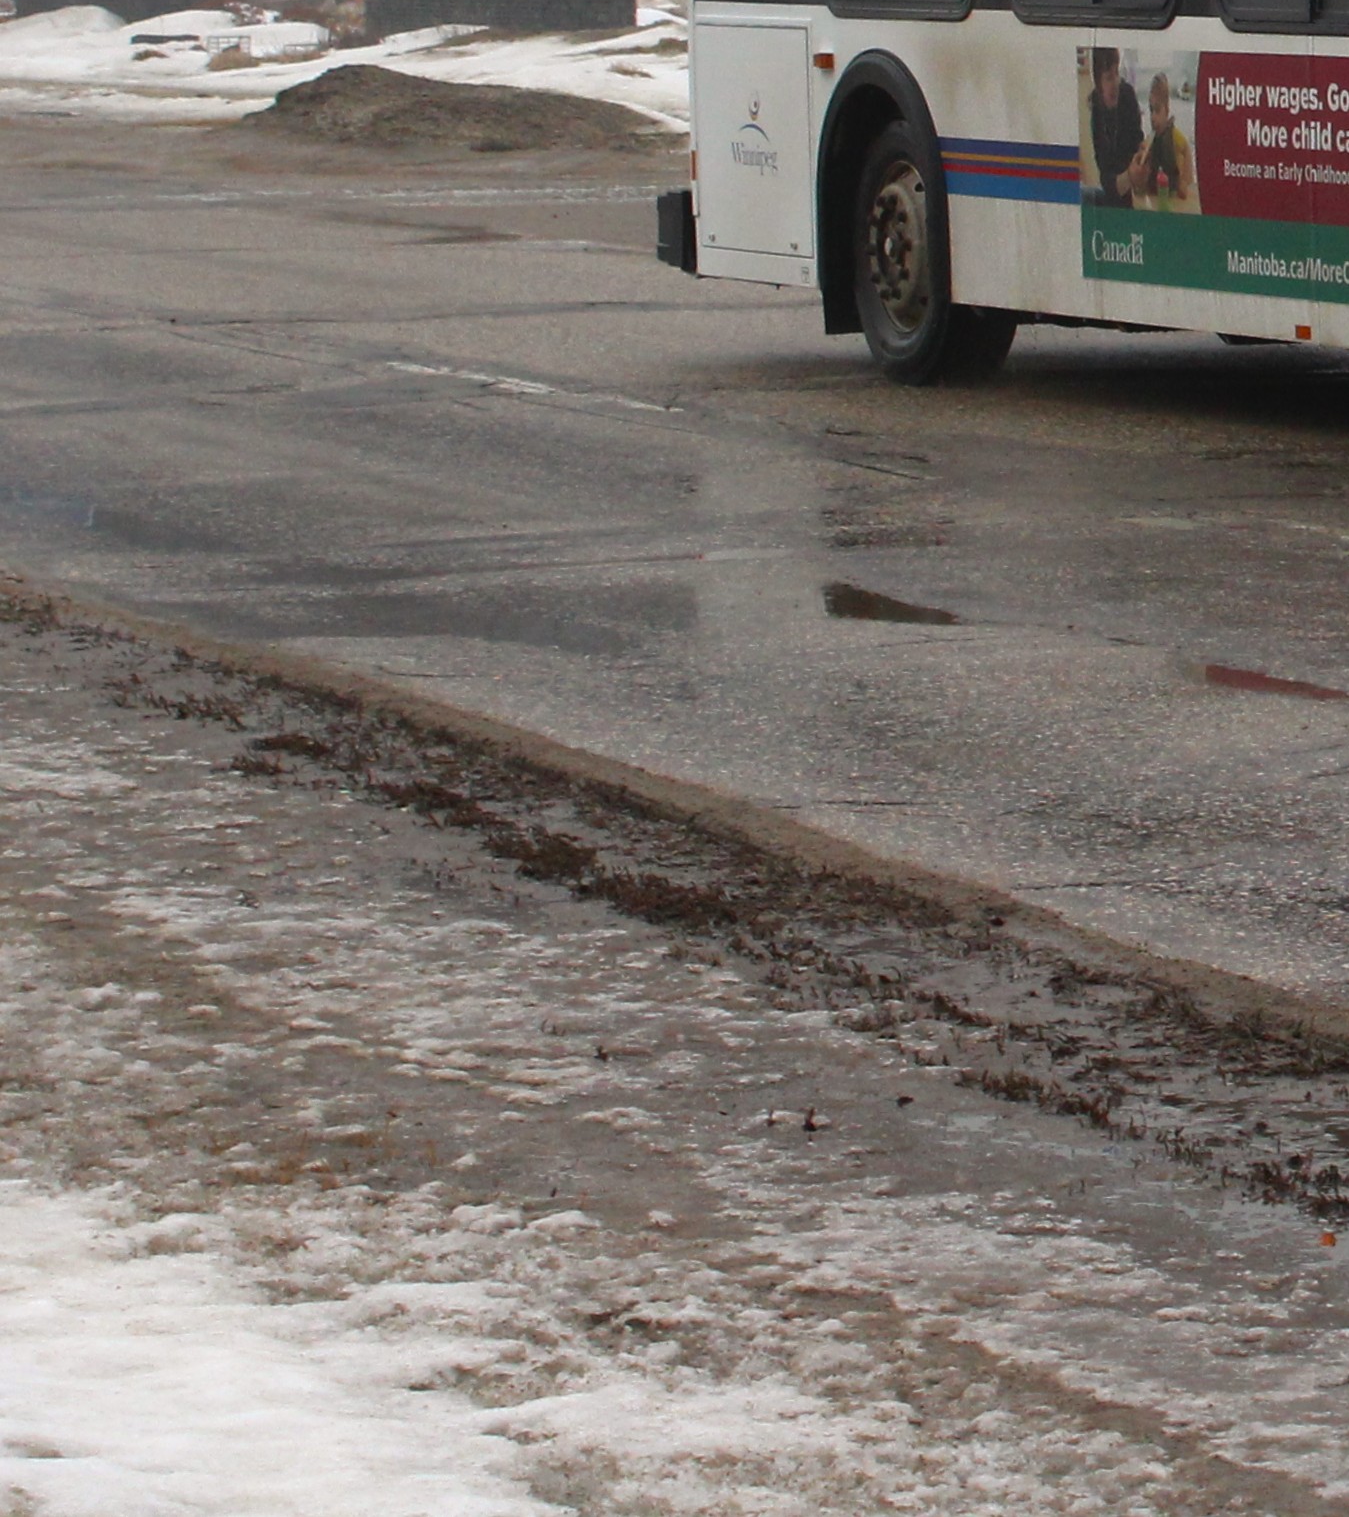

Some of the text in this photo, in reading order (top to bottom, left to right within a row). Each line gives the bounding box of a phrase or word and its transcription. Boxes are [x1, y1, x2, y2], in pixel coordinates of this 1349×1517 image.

[1208, 78, 1262, 111] Higher
[1266, 85, 1323, 114] wages.
[1247, 118, 1288, 148] More
[1292, 120, 1332, 151] child
[731, 142, 778, 176] Winnipeg
[1224, 159, 1262, 179] Become
[1263, 166, 1275, 179] an
[1278, 162, 1302, 186] Early
[1092, 230, 1144, 265] Canada
